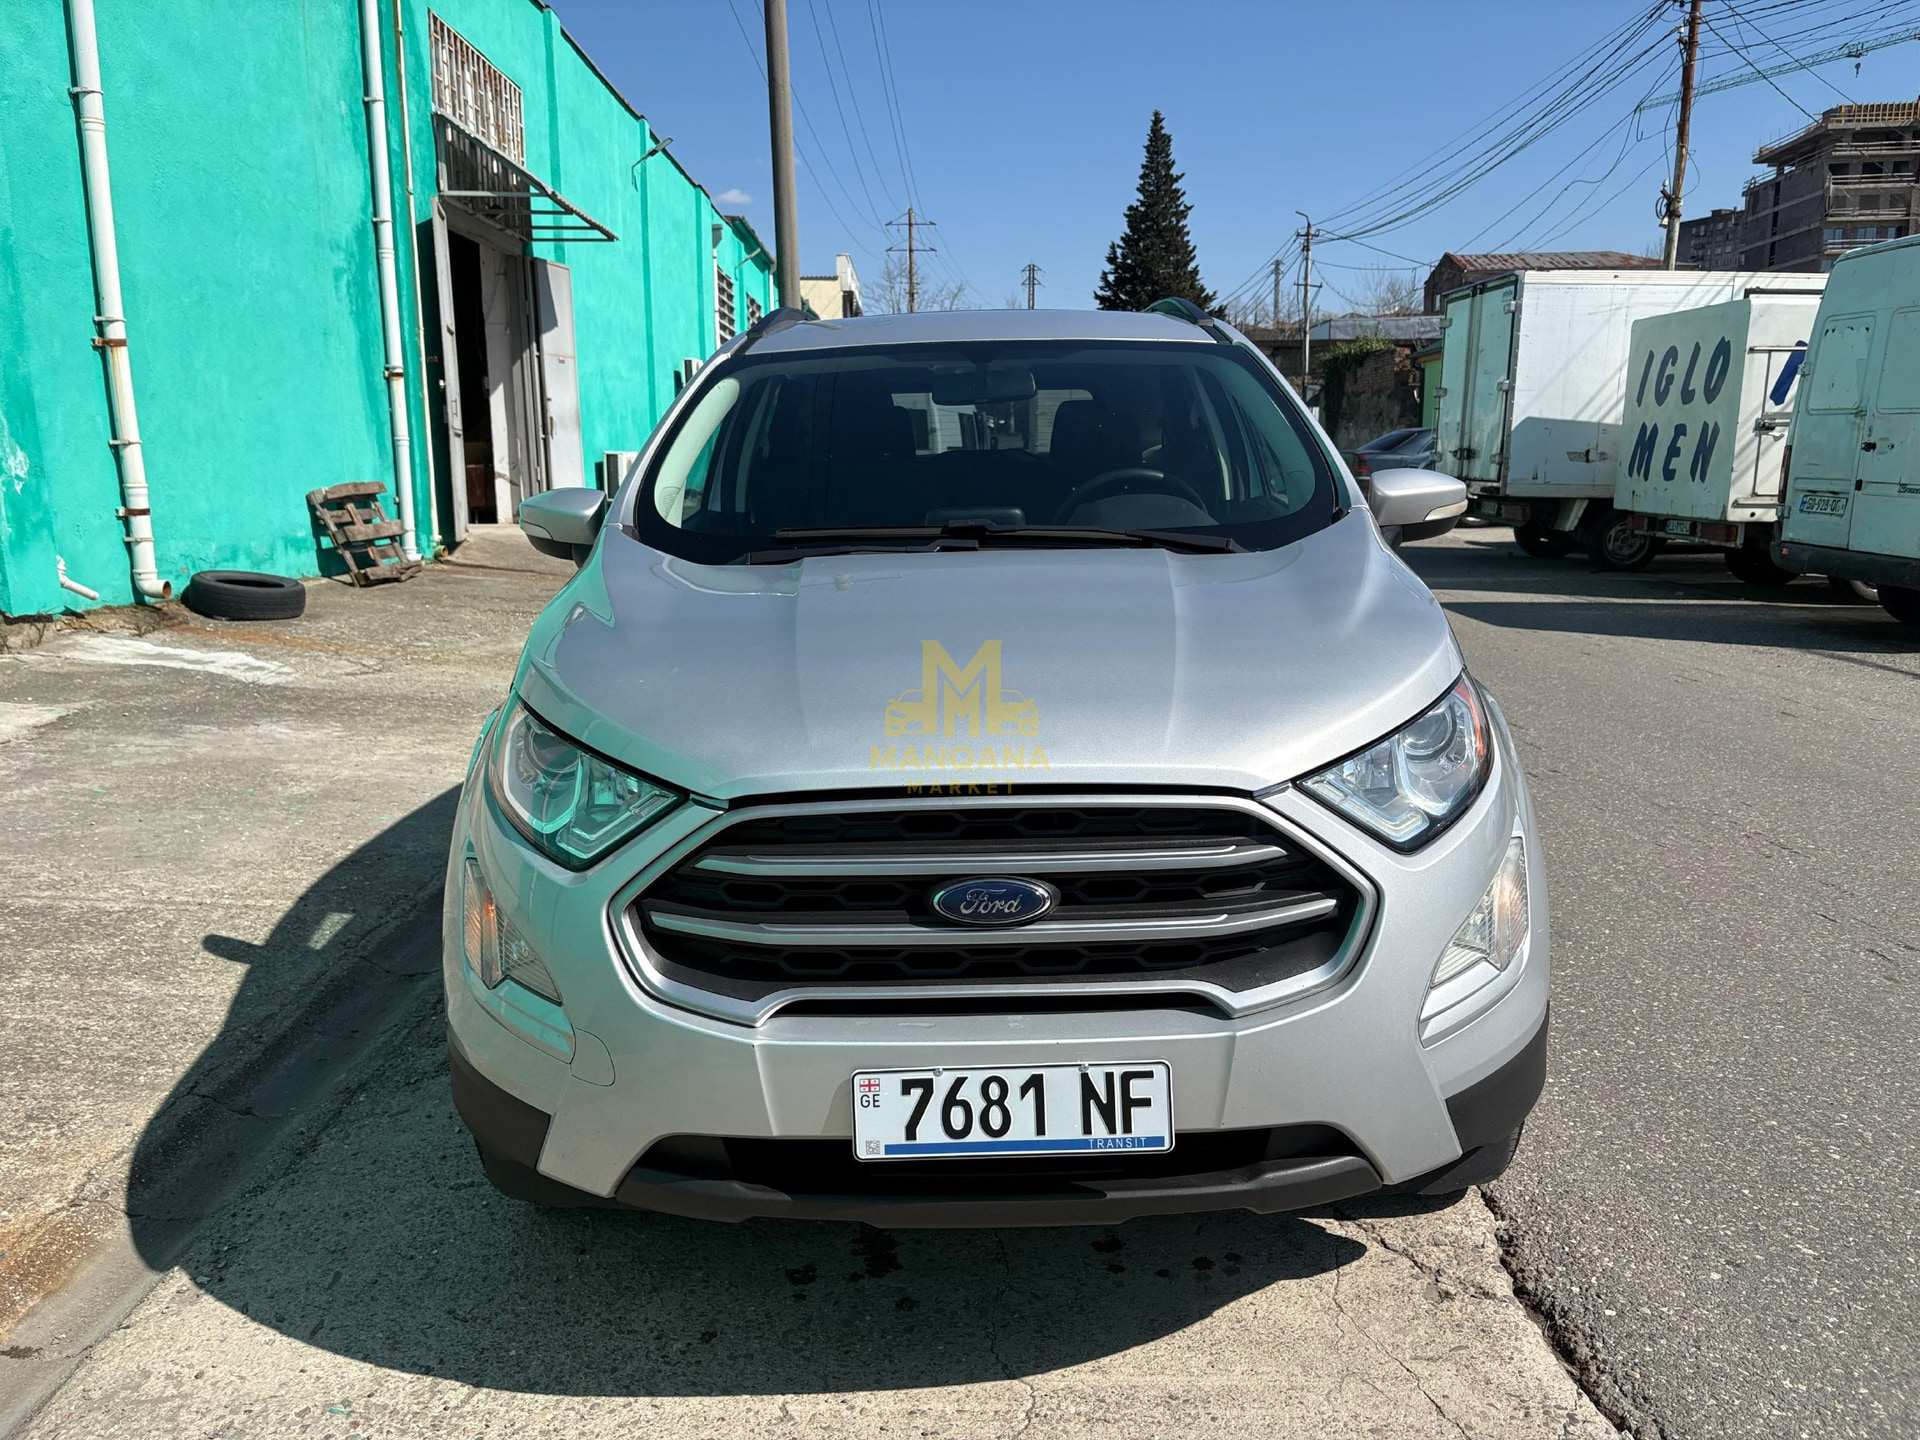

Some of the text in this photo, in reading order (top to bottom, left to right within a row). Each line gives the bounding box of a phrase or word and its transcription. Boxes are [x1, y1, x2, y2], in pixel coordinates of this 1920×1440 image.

[1636, 335, 1731, 408] IGLO
[1628, 420, 1720, 484] MEN
[960, 888, 1022, 914] Ford
[860, 1093, 881, 1108] GE
[901, 1069, 1155, 1141] 7681 NF
[1087, 1137, 1147, 1149] TRANSIT
